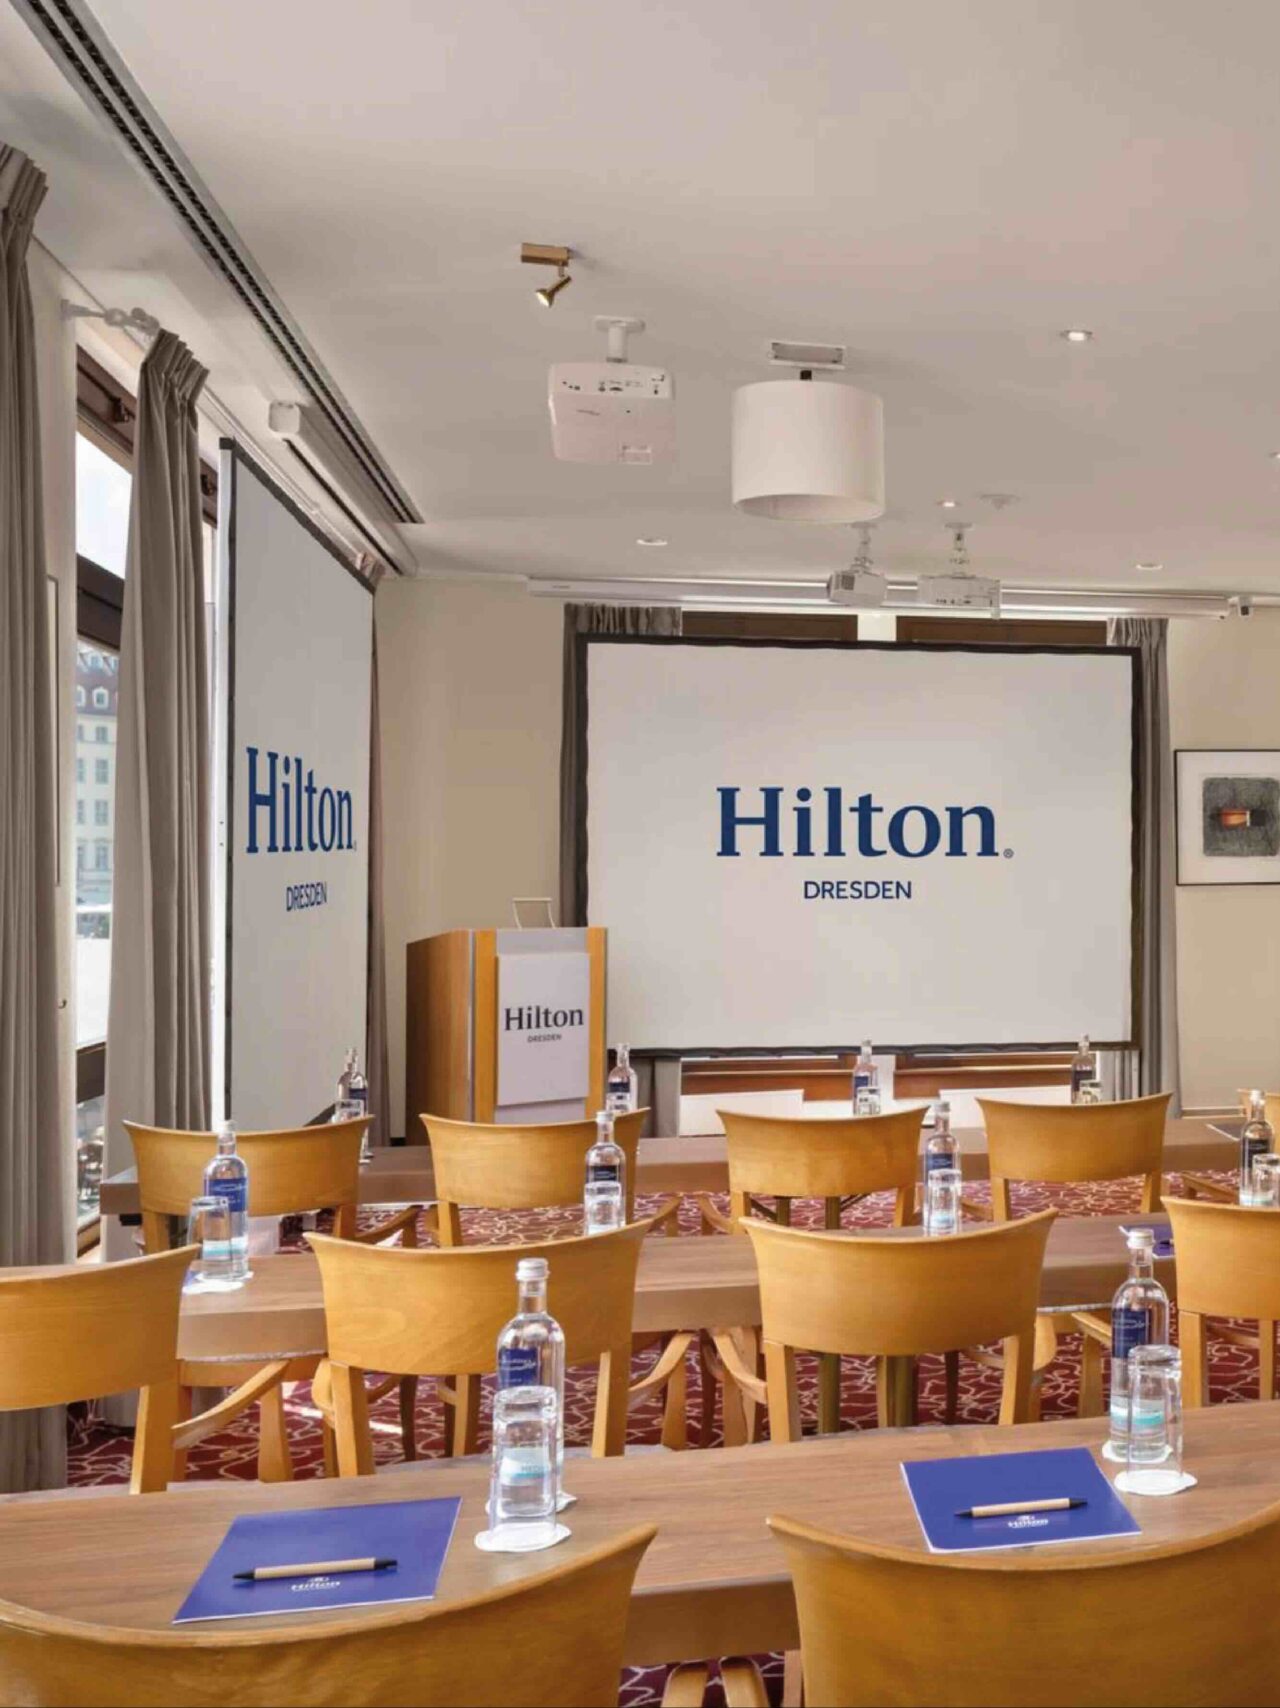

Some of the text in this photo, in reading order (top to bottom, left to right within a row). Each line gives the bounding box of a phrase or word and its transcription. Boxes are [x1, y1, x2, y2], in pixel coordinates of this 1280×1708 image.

[246, 746, 353, 854] Hilton
[716, 786, 1000, 858] Hilton
[286, 881, 327, 912] DRESDEN
[803, 880, 912, 900] DRESDEN
[504, 1005, 584, 1031] Hilton
[527, 1033, 562, 1043] DRESDEN
